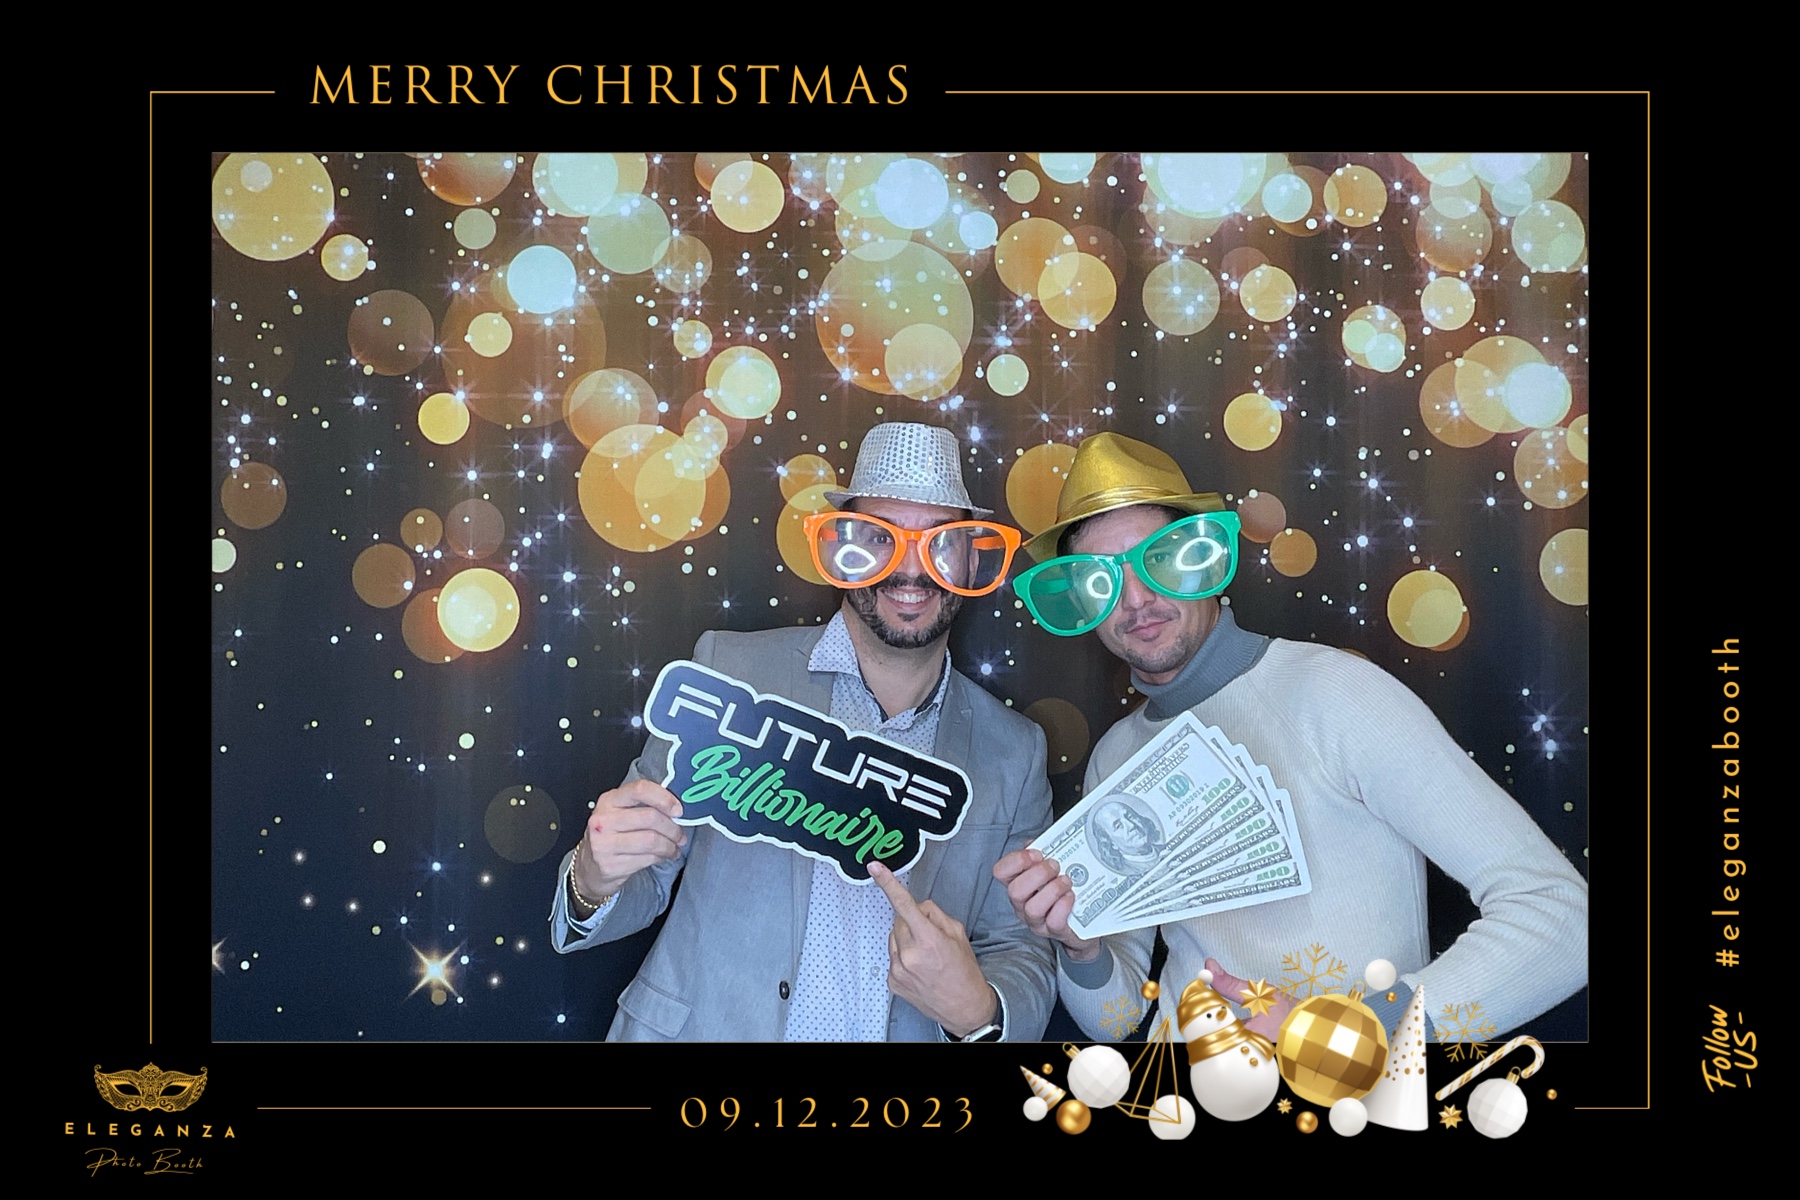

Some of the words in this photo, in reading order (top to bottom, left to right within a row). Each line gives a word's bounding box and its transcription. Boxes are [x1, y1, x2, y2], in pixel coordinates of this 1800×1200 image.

[668, 684, 952, 819] FUTURE
[681, 744, 904, 864] Billionaire
[1202, 778, 1231, 806] 100
[1220, 797, 1250, 822] 100
[1235, 818, 1267, 840] 100
[1246, 841, 1280, 861] 100
[1256, 865, 1291, 882] 100
